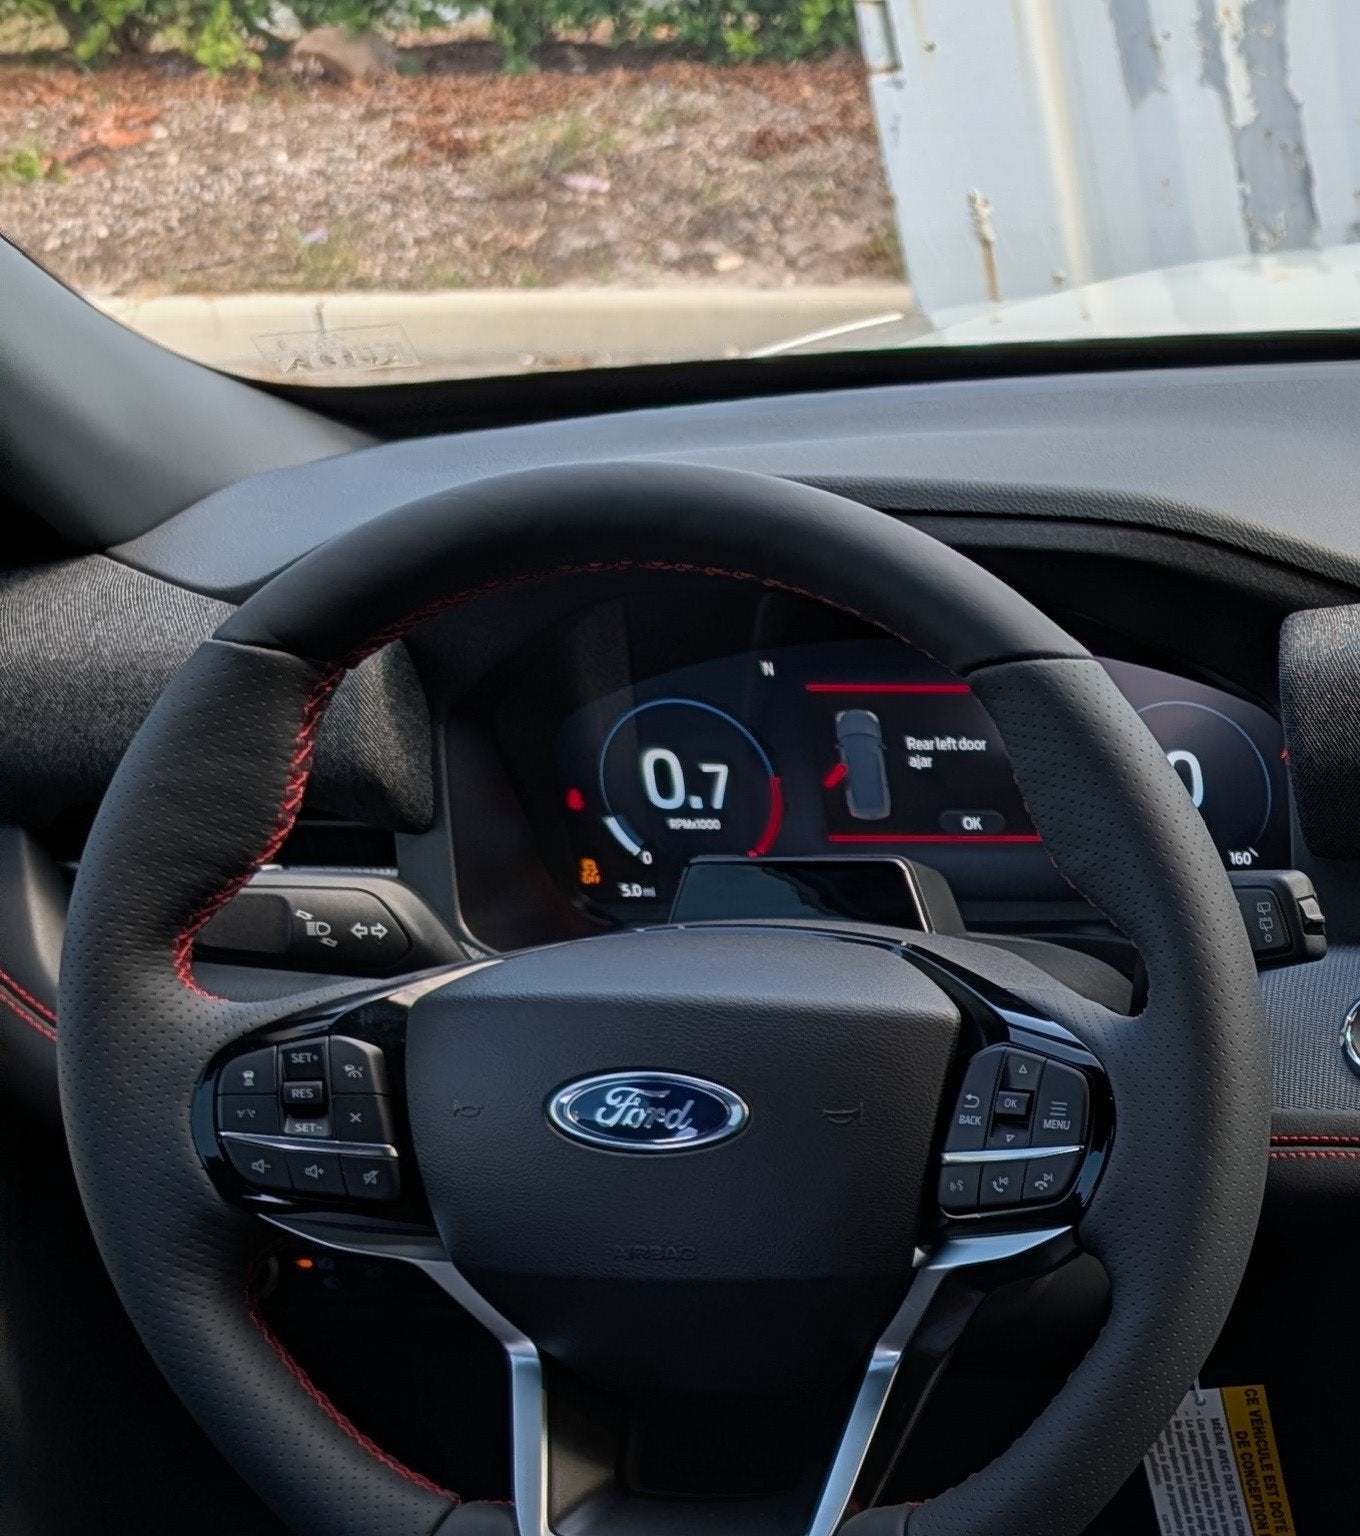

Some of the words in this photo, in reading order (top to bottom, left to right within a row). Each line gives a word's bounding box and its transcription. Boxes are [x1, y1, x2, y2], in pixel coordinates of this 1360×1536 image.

[760, 660, 775, 677] N
[905, 735, 935, 750] Rear
[935, 736, 958, 750] left
[958, 736, 987, 751] door
[908, 754, 933, 770] ajar
[640, 747, 729, 810] 0.7
[961, 816, 984, 831] OK
[641, 850, 653, 865] 0
[1228, 850, 1252, 866] 160
[618, 882, 643, 898] 5.0
[643, 884, 656, 897] mi
[290, 1053, 319, 1063] SET+
[291, 1088, 314, 1099] RES
[595, 1086, 696, 1130] Ford
[1004, 1098, 1018, 1109] OK
[958, 1114, 982, 1126] BACK
[1042, 1119, 1071, 1131] MENU
[613, 1244, 696, 1261] AIRBAG
[1242, 1388, 1260, 1406] CE
[1234, 1431, 1251, 1448] DE
[1246, 1409, 1277, 1471] VÉHICULE
[1217, 1448, 1232, 1471] AVEC
[1222, 1474, 1236, 1491] DES
[1238, 1452, 1271, 1529] CONCEPTION
[1262, 1474, 1280, 1498] EST
[1226, 1494, 1243, 1517] SACS
[1268, 1500, 1291, 1533] DOTÉ
